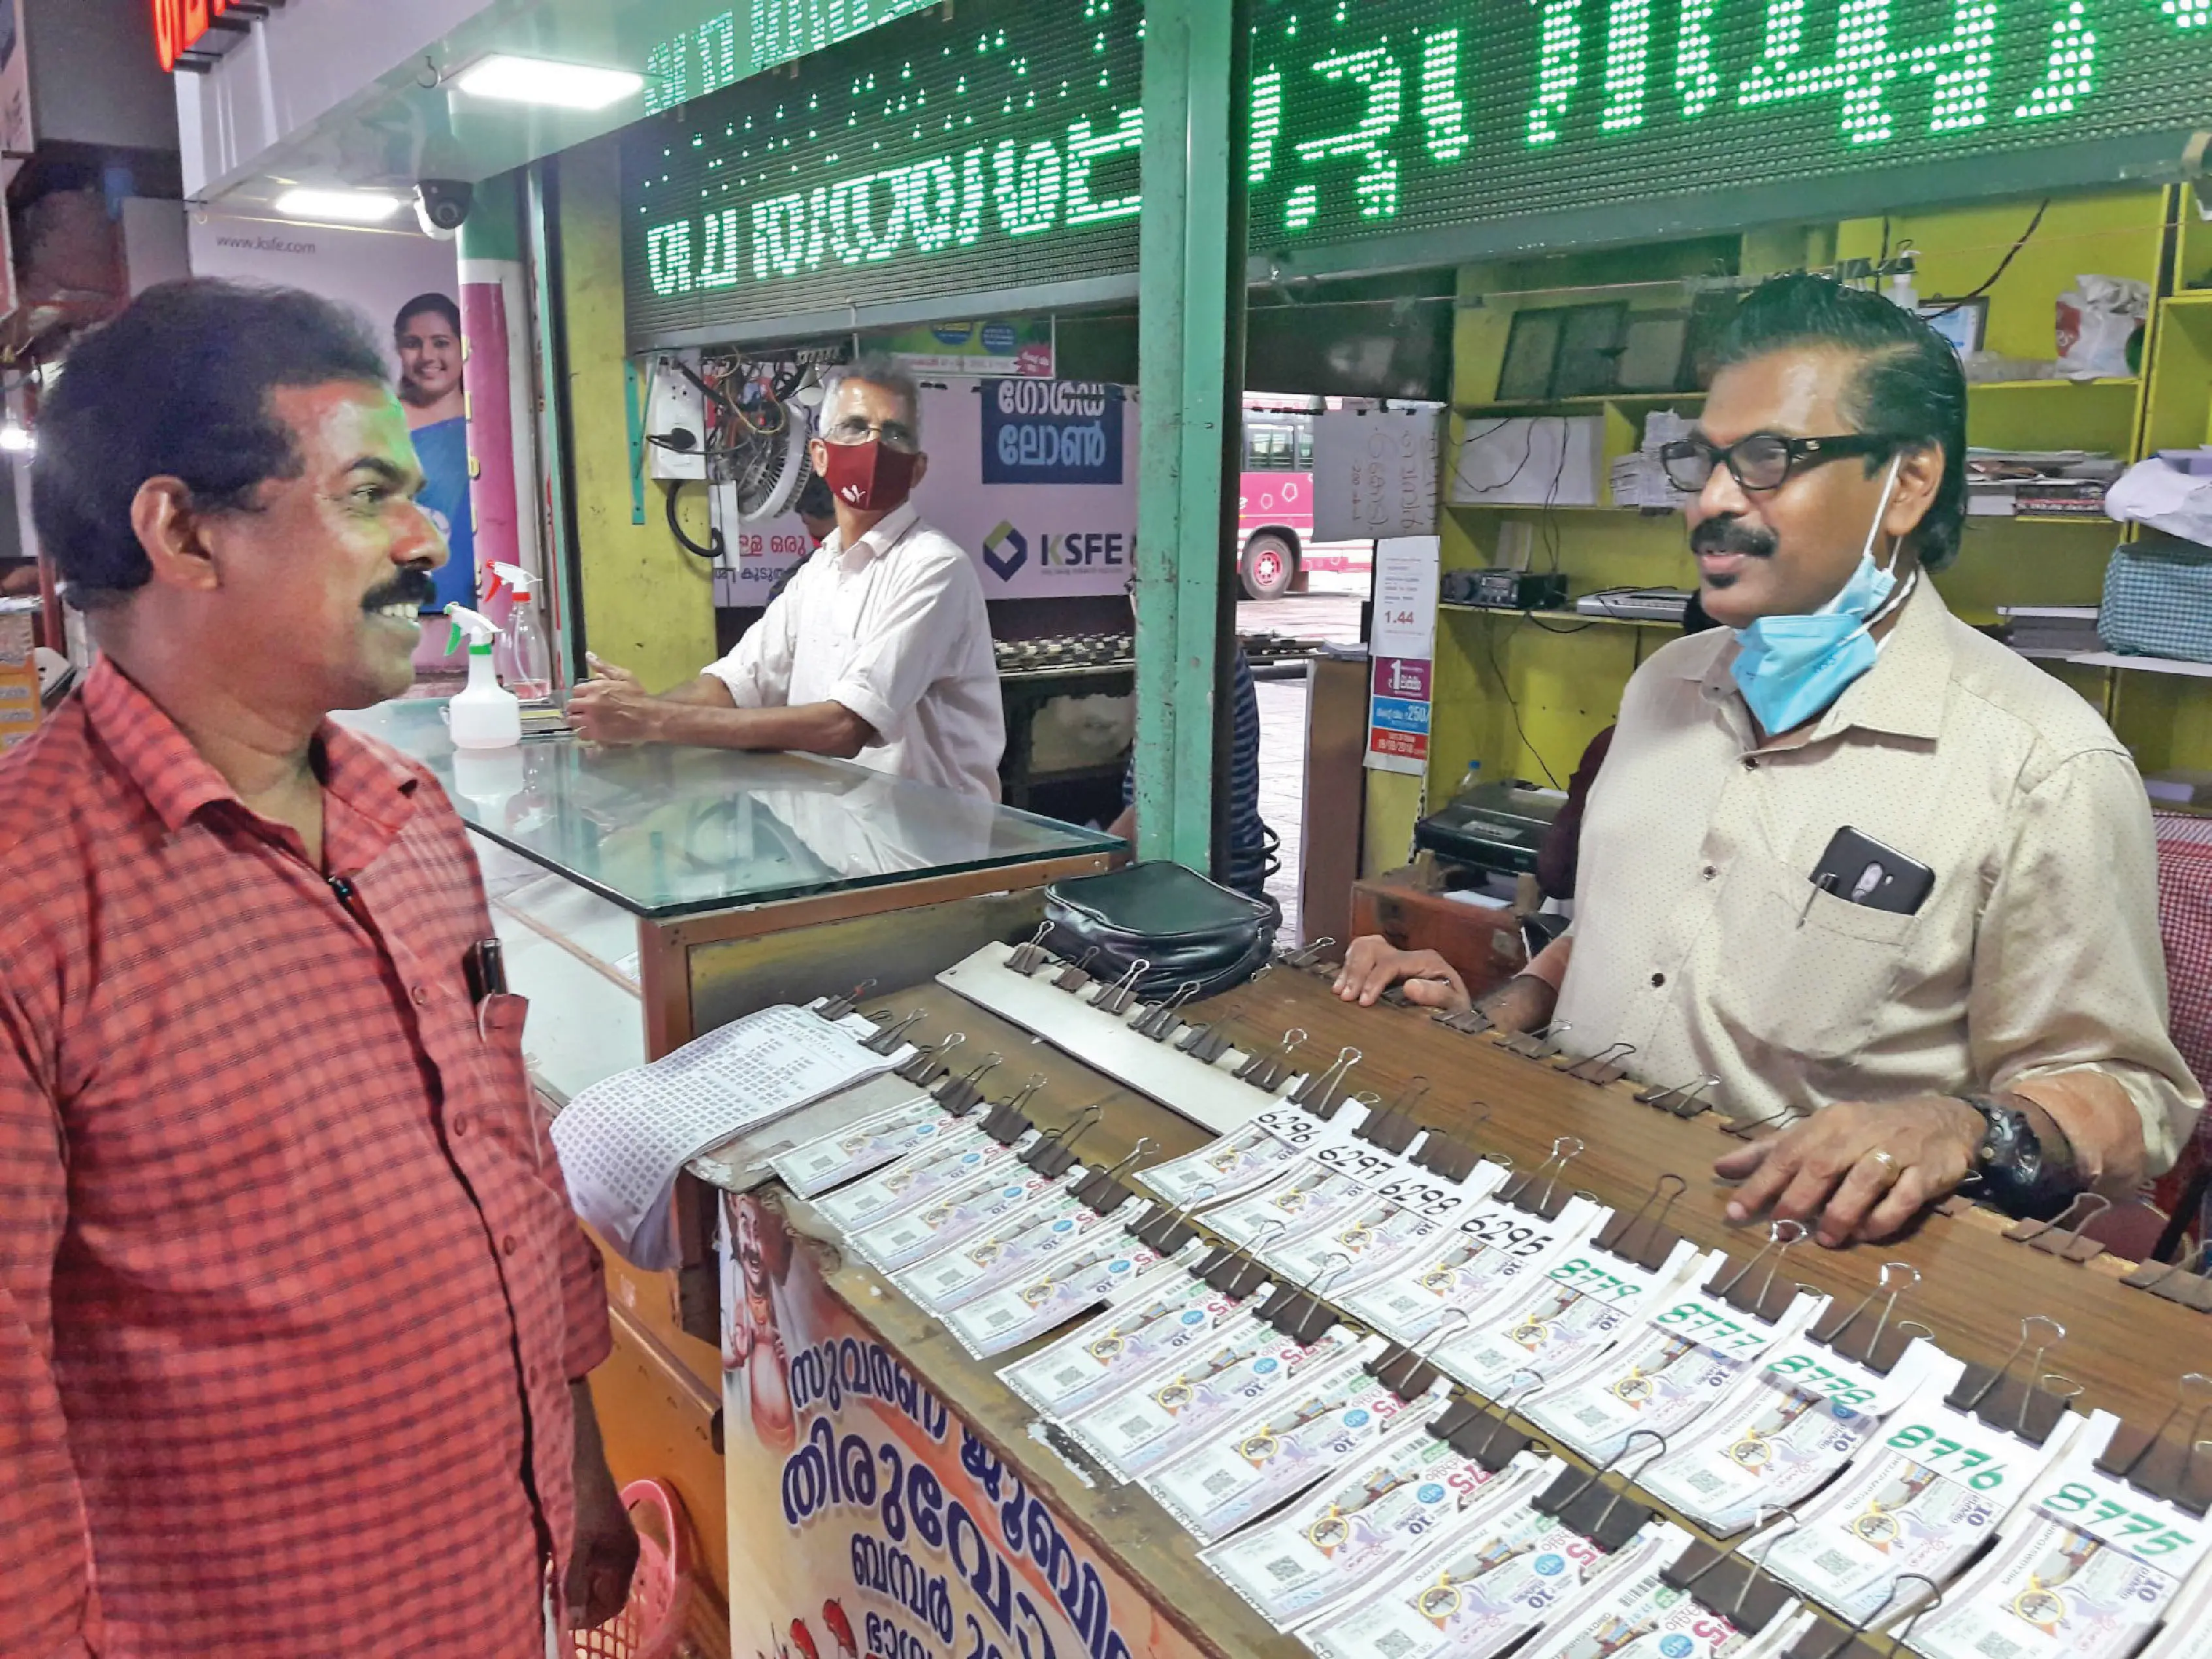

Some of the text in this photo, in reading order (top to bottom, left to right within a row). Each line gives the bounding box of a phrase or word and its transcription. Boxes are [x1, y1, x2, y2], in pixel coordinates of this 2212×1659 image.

[1041, 534, 1122, 566] KSFE
[1384, 610, 1414, 624] 1.44
[1258, 1110, 1322, 1143] 6296
[1318, 1145, 1396, 1181] 6297
[1378, 1178, 1461, 1215] 6298
[1460, 1213, 1554, 1256] 6295
[1549, 1258, 1642, 1302] 8779
[1657, 1302, 1766, 1349] 8777
[1766, 1354, 1876, 1405] 8778
[1334, 1436, 1356, 1453] 10
[1887, 1424, 2008, 1490] 8776
[1408, 1515, 1433, 1535] 10
[1967, 1504, 1993, 1528] 10
[2042, 1483, 2196, 1556] 8775
[1527, 1588, 1555, 1609] 10
[2138, 1576, 2167, 1604] 10
